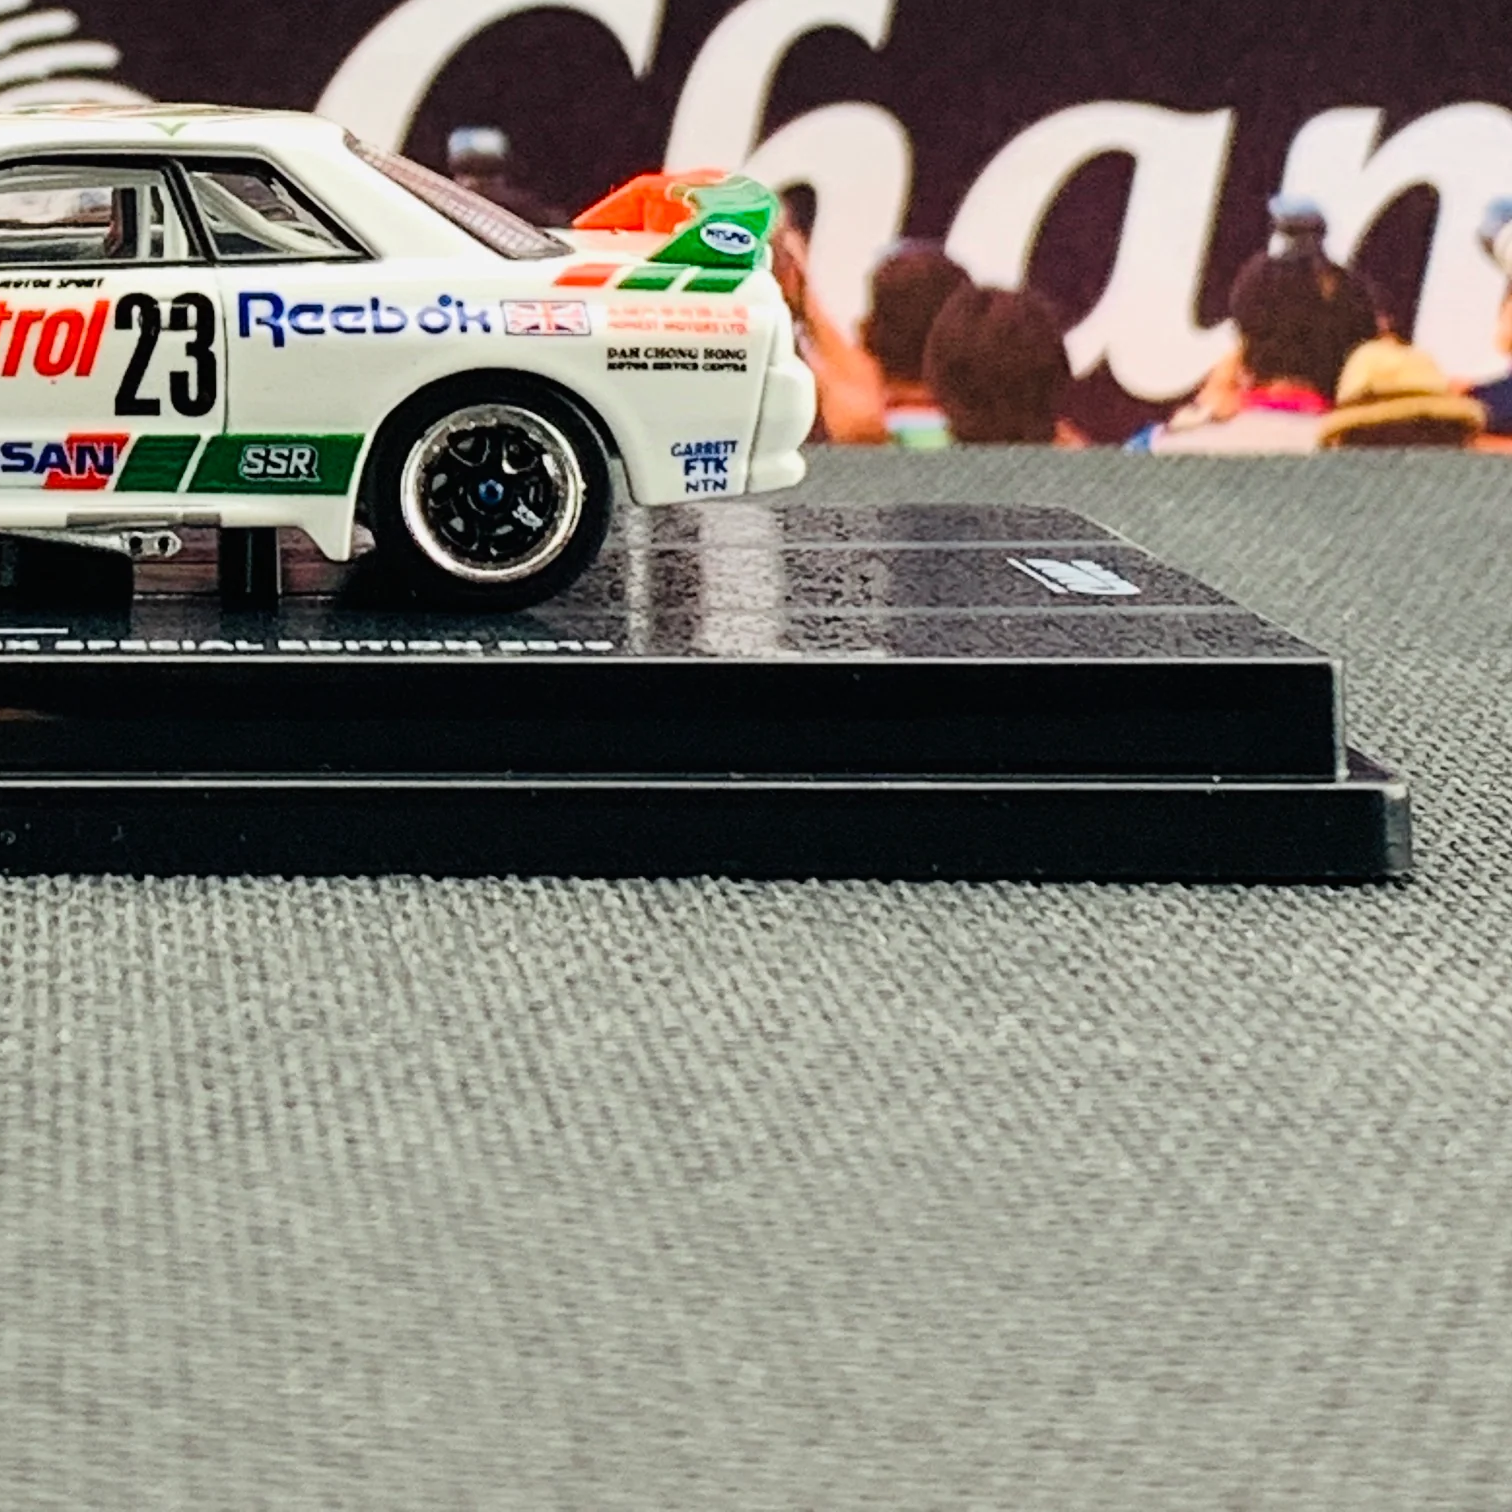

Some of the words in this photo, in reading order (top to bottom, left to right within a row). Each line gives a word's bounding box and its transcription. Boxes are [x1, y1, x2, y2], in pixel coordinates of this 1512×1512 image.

[56, 277, 104, 289] SPORT
[237, 291, 492, 348] Reebok
[113, 291, 218, 417] 23
[643, 346, 699, 360] CHONG
[703, 347, 748, 361] HONG
[652, 362, 699, 372] SERVICE
[670, 440, 738, 458] GARRETT
[241, 445, 316, 478] SSR
[683, 455, 728, 476] FTK
[685, 477, 728, 495] NTN
